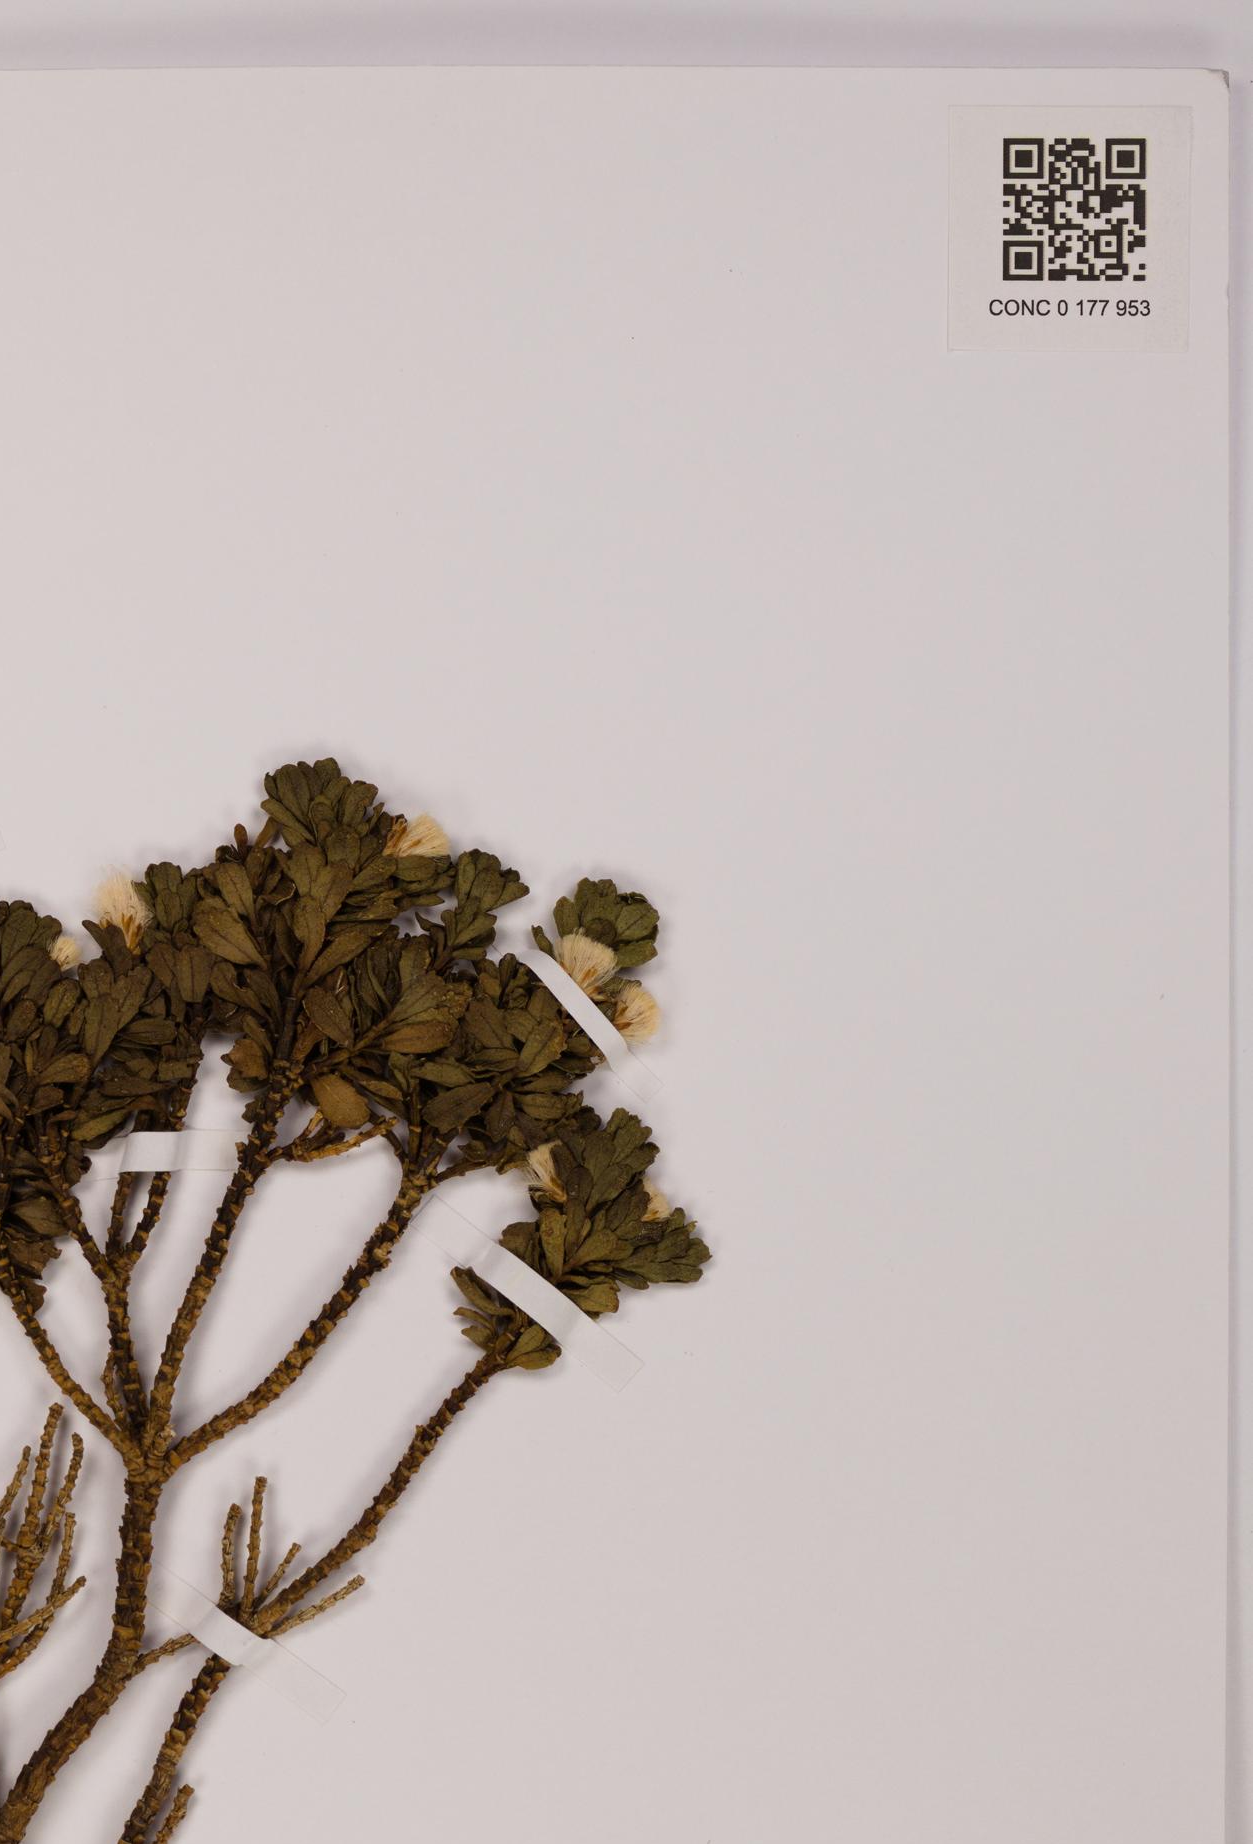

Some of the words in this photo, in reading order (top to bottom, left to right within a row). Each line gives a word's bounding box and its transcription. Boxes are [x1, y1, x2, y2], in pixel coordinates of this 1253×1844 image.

[988, 299, 1051, 317] CONC
[1057, 299, 1069, 317] 0
[1075, 299, 1110, 317] 177
[1115, 299, 1151, 317] 953
